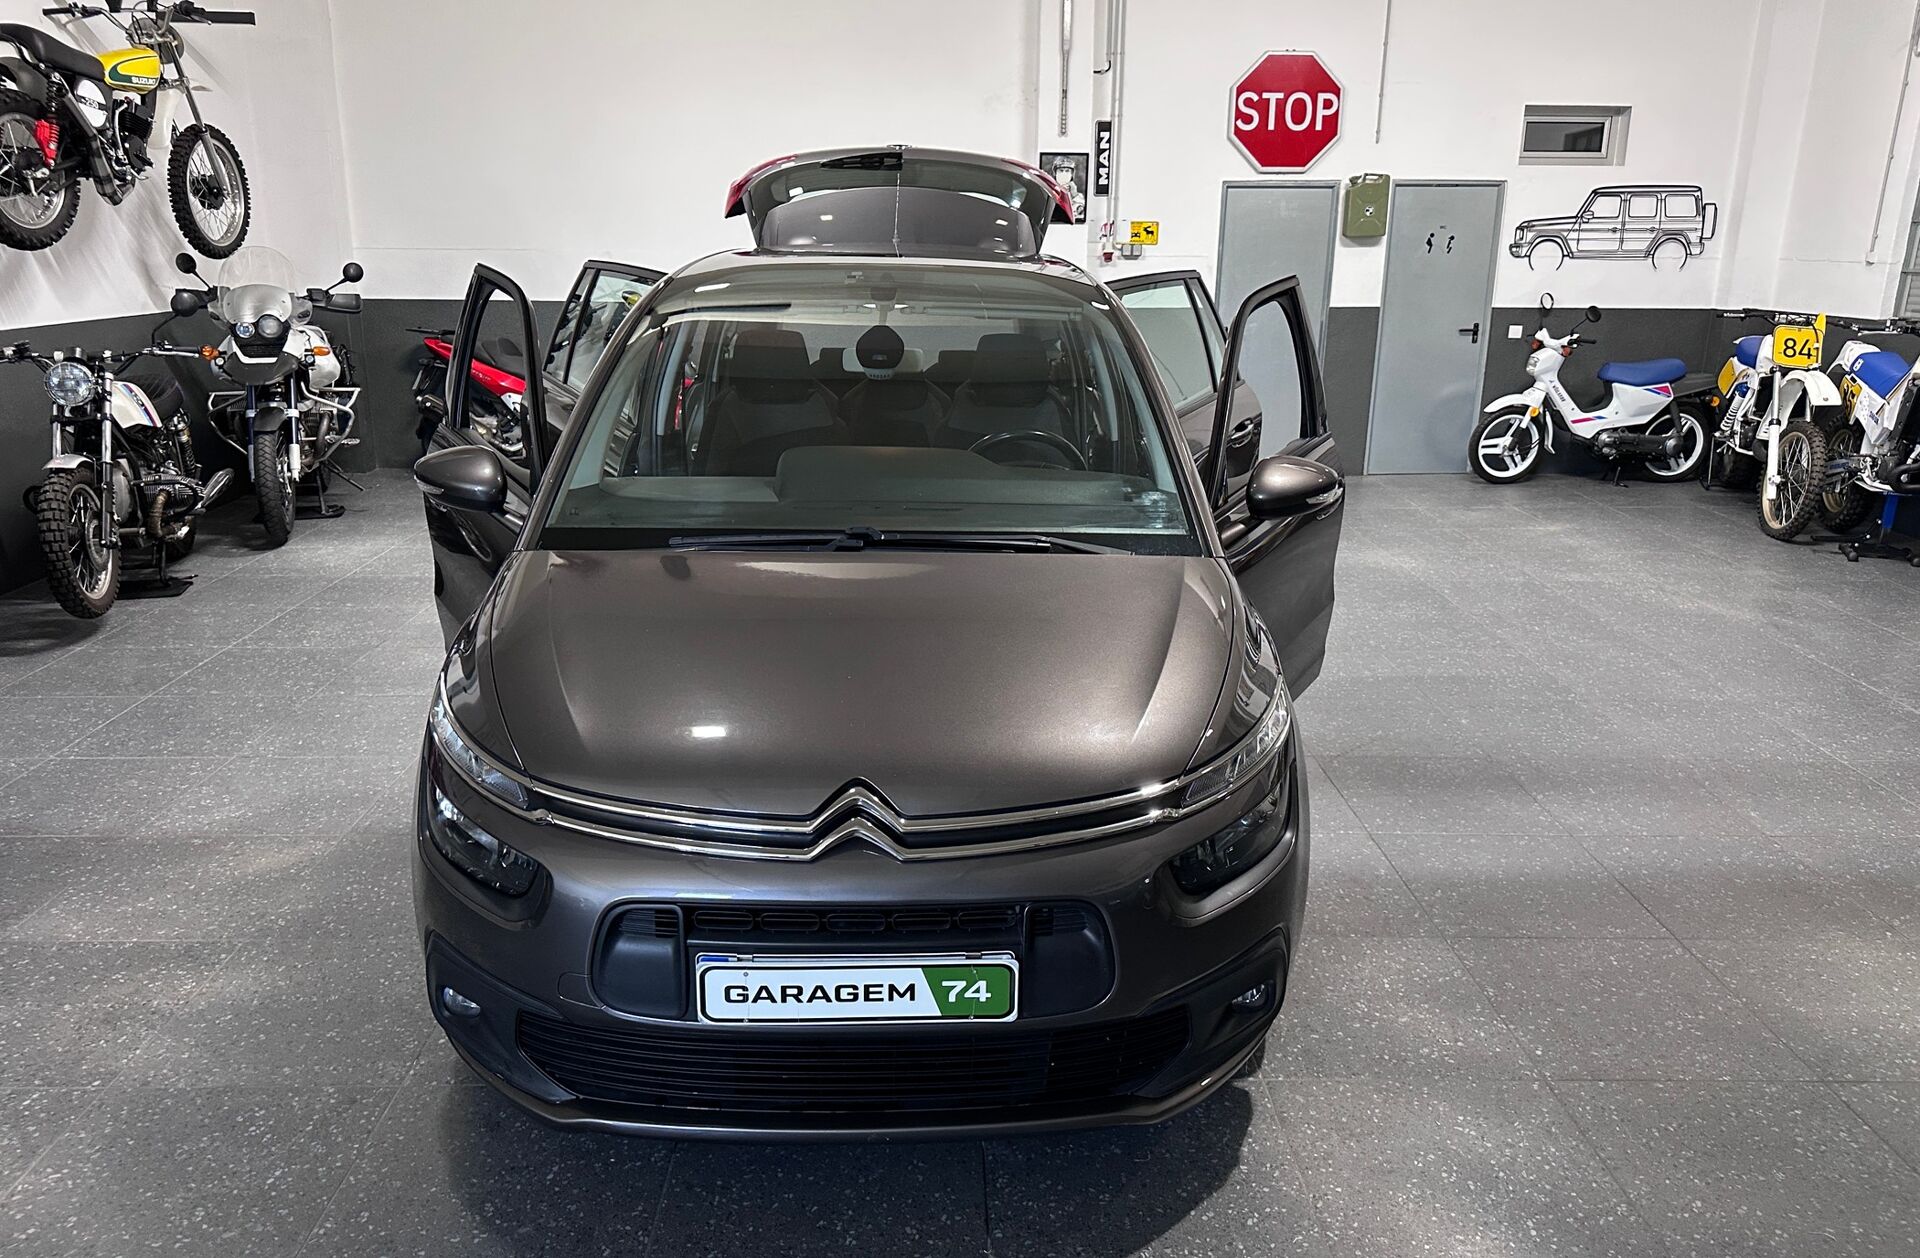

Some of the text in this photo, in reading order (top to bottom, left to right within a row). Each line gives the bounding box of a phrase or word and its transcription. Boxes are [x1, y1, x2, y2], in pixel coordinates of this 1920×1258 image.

[1236, 91, 1339, 131] STOP
[1098, 131, 1110, 185] MAN
[1783, 338, 1811, 359] 84
[724, 980, 992, 1004] GARAGEM 74
